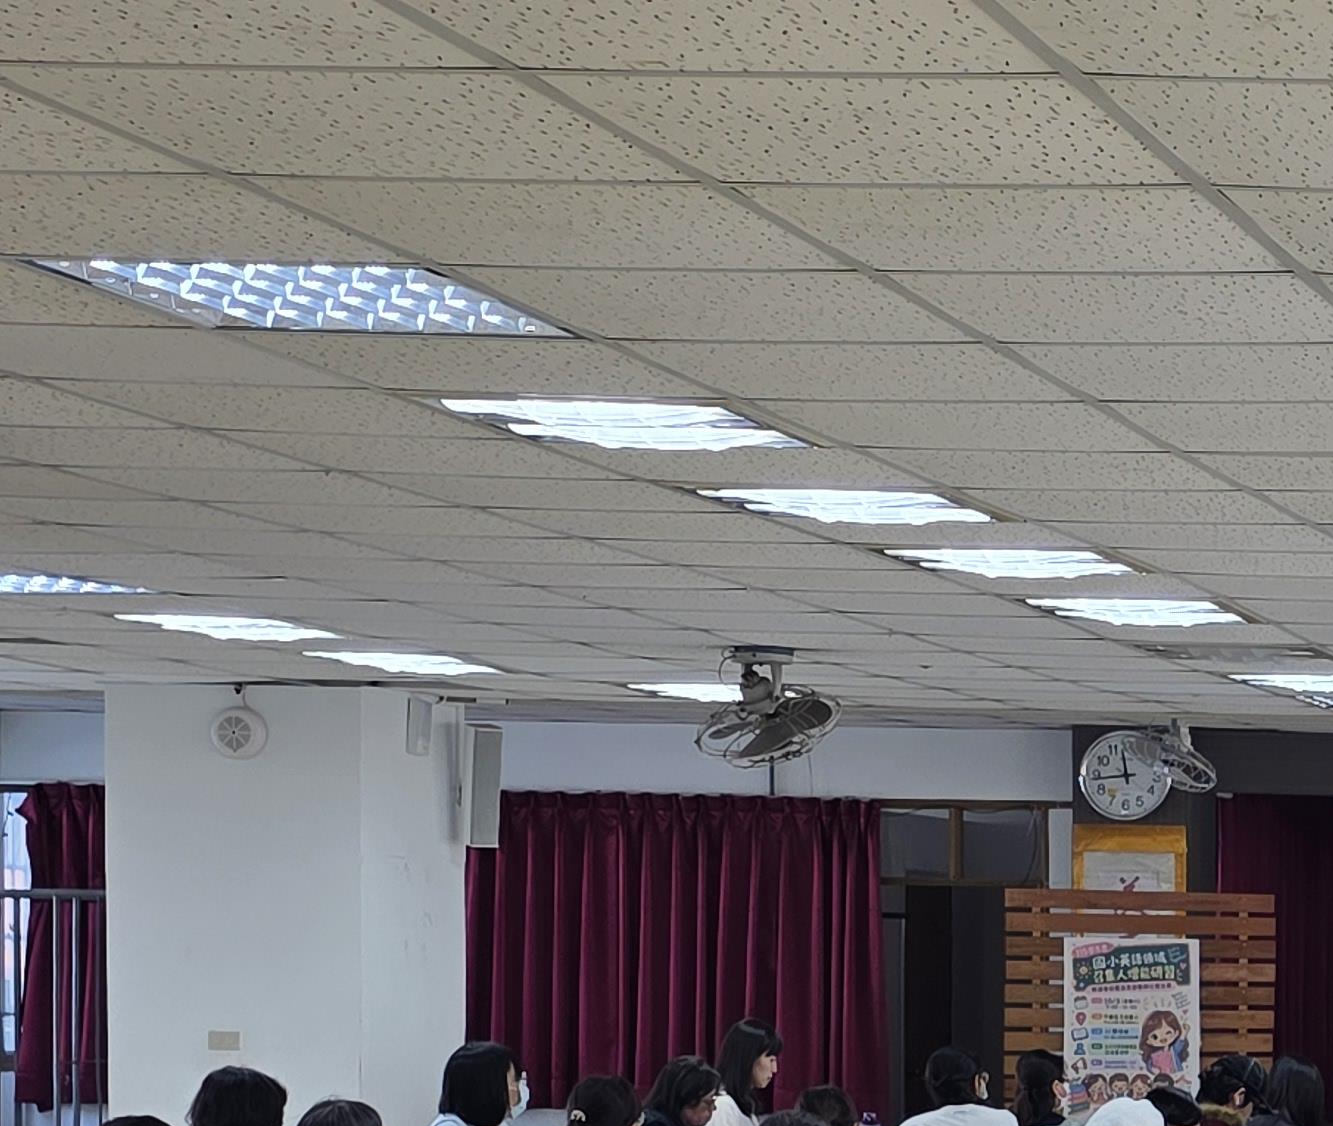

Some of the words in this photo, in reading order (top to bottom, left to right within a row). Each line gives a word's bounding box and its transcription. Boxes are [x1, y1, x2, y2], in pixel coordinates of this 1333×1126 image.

[1108, 744, 1117, 756] 11
[1097, 754, 1110, 767] 10
[1096, 783, 1106, 796] 8
[1147, 784, 1155, 796] 4
[1121, 798, 1130, 811] 6
[1135, 795, 1145, 807] 5
